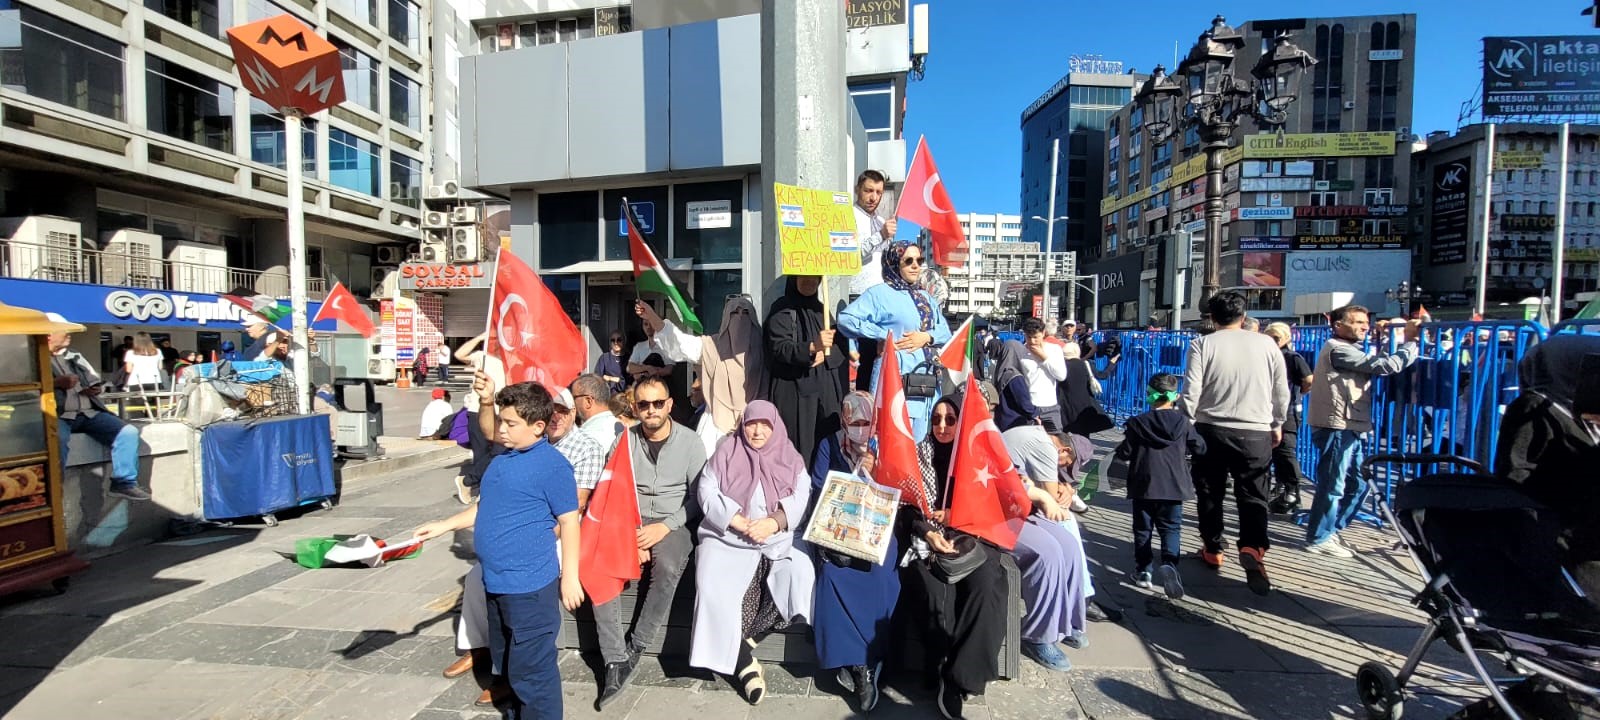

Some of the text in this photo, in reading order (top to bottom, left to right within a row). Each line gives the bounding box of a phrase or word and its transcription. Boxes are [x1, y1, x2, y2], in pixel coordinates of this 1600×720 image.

[257, 25, 308, 52] M
[242, 56, 280, 95] M
[294, 65, 336, 104] M
[1488, 95, 1535, 103] AKSESUAR
[1250, 138, 1274, 149] CITI
[1285, 137, 1327, 150] English
[1242, 207, 1290, 218] gezinomi
[1300, 235, 1347, 243] EPİLASYON
[1359, 235, 1402, 243] GÜZELLİK
[402, 265, 485, 278] SOYSAL
